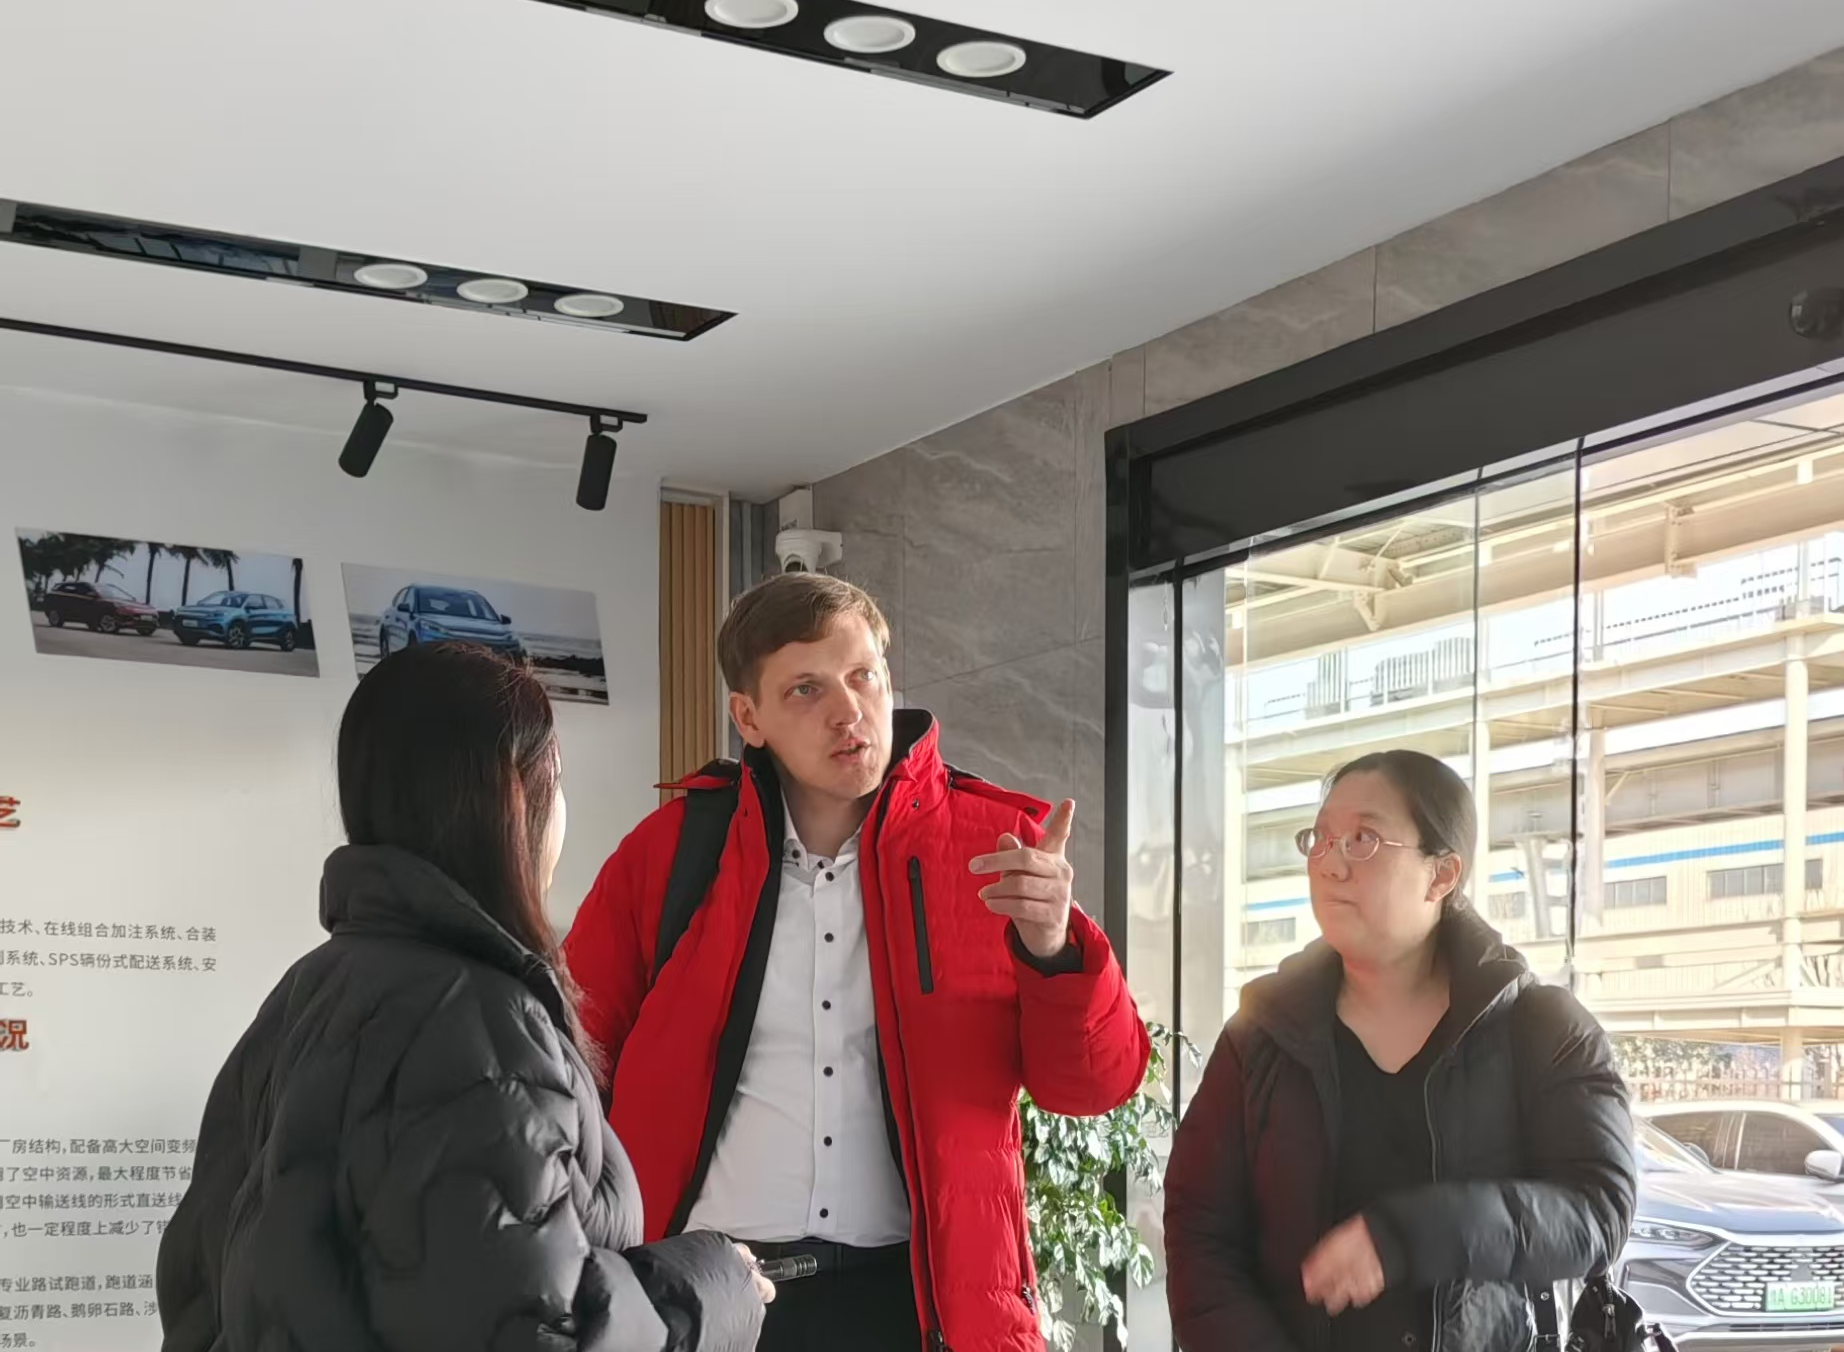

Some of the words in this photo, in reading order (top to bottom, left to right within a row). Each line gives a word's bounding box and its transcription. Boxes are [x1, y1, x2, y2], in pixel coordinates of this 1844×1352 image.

[0, 949, 217, 972] 系统、SPS辆份式配送系统、安
[0, 1165, 191, 1182] 了空中资源，最大程度节省
[0, 1192, 182, 1209] 空中输送线的形式直送线
